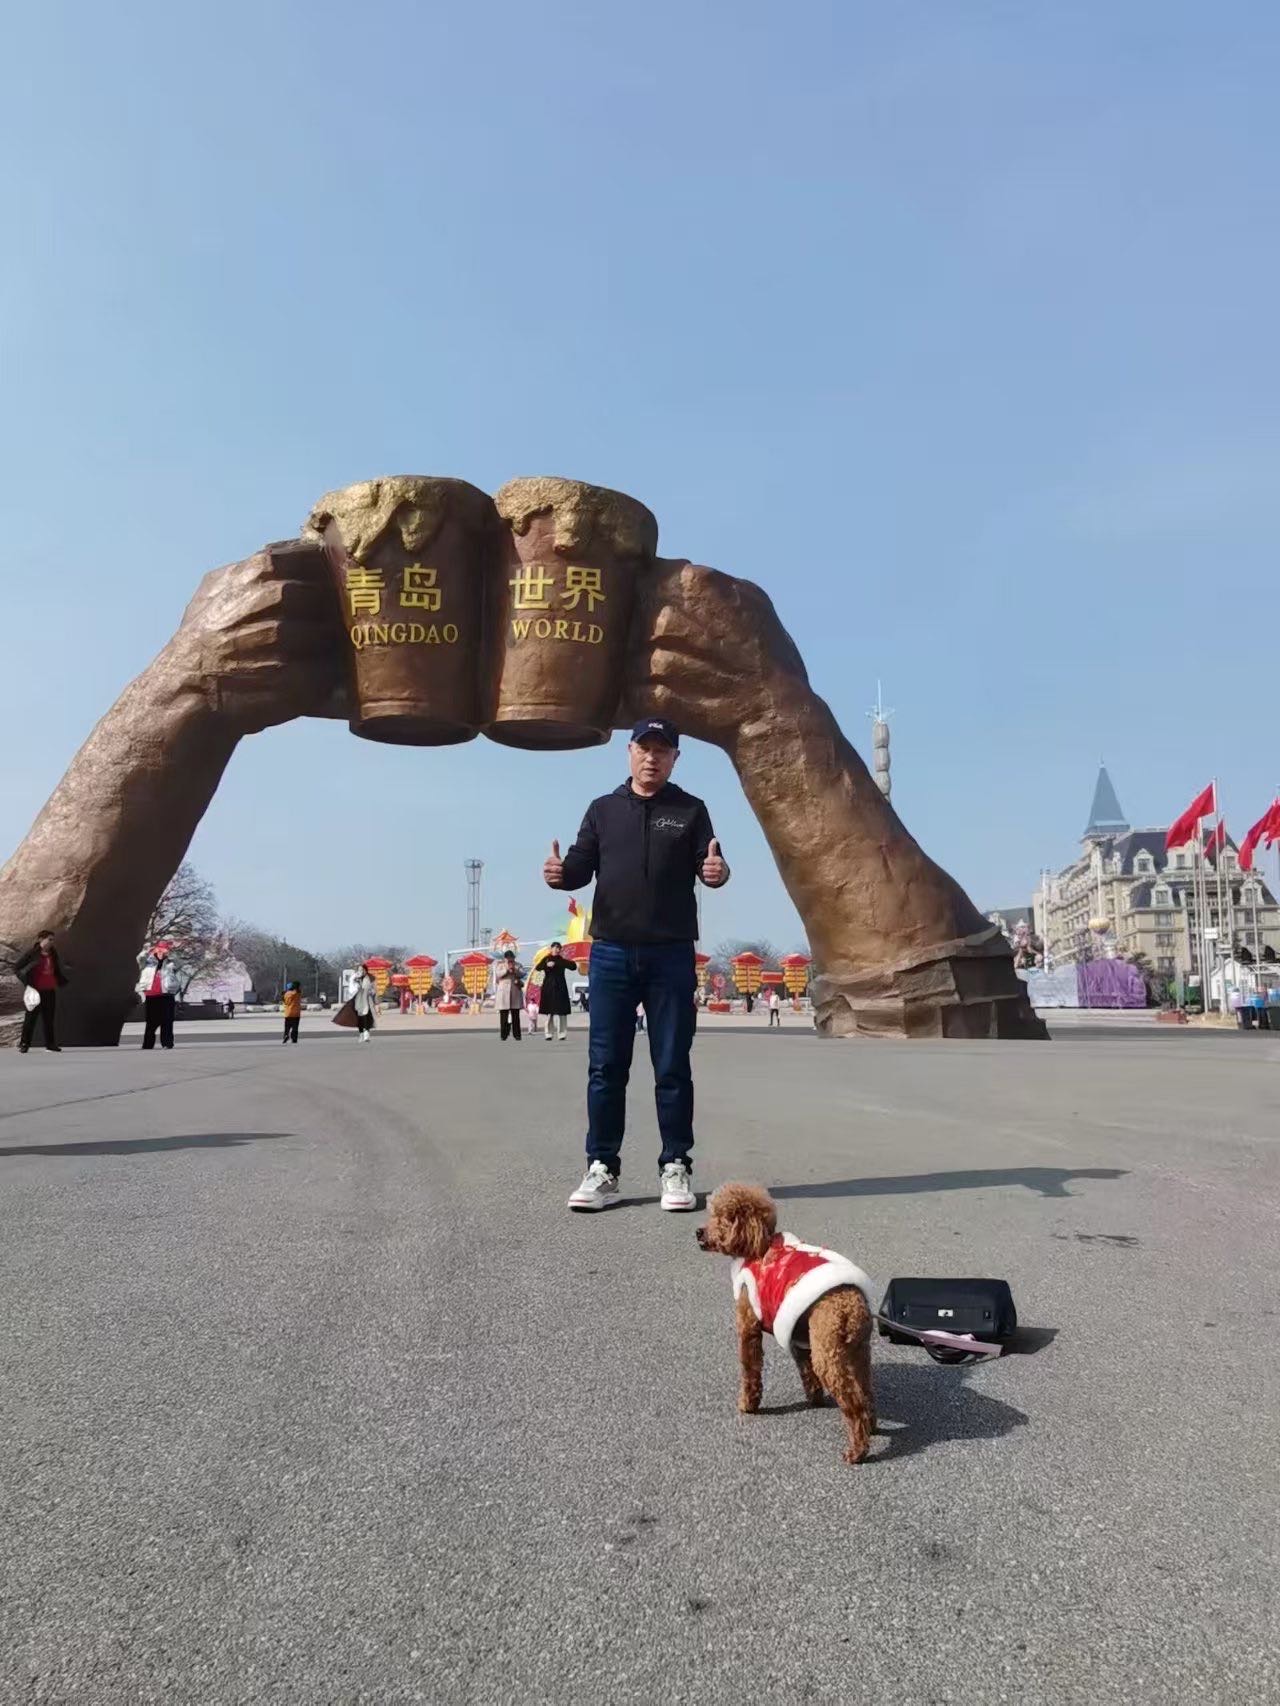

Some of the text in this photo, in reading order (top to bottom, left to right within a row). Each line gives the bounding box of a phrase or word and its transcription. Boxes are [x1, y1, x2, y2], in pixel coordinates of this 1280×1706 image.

[346, 563, 441, 616] 青岛
[509, 566, 606, 612] 世界
[350, 622, 458, 649] QINGDAO
[511, 618, 604, 644] WORLD
